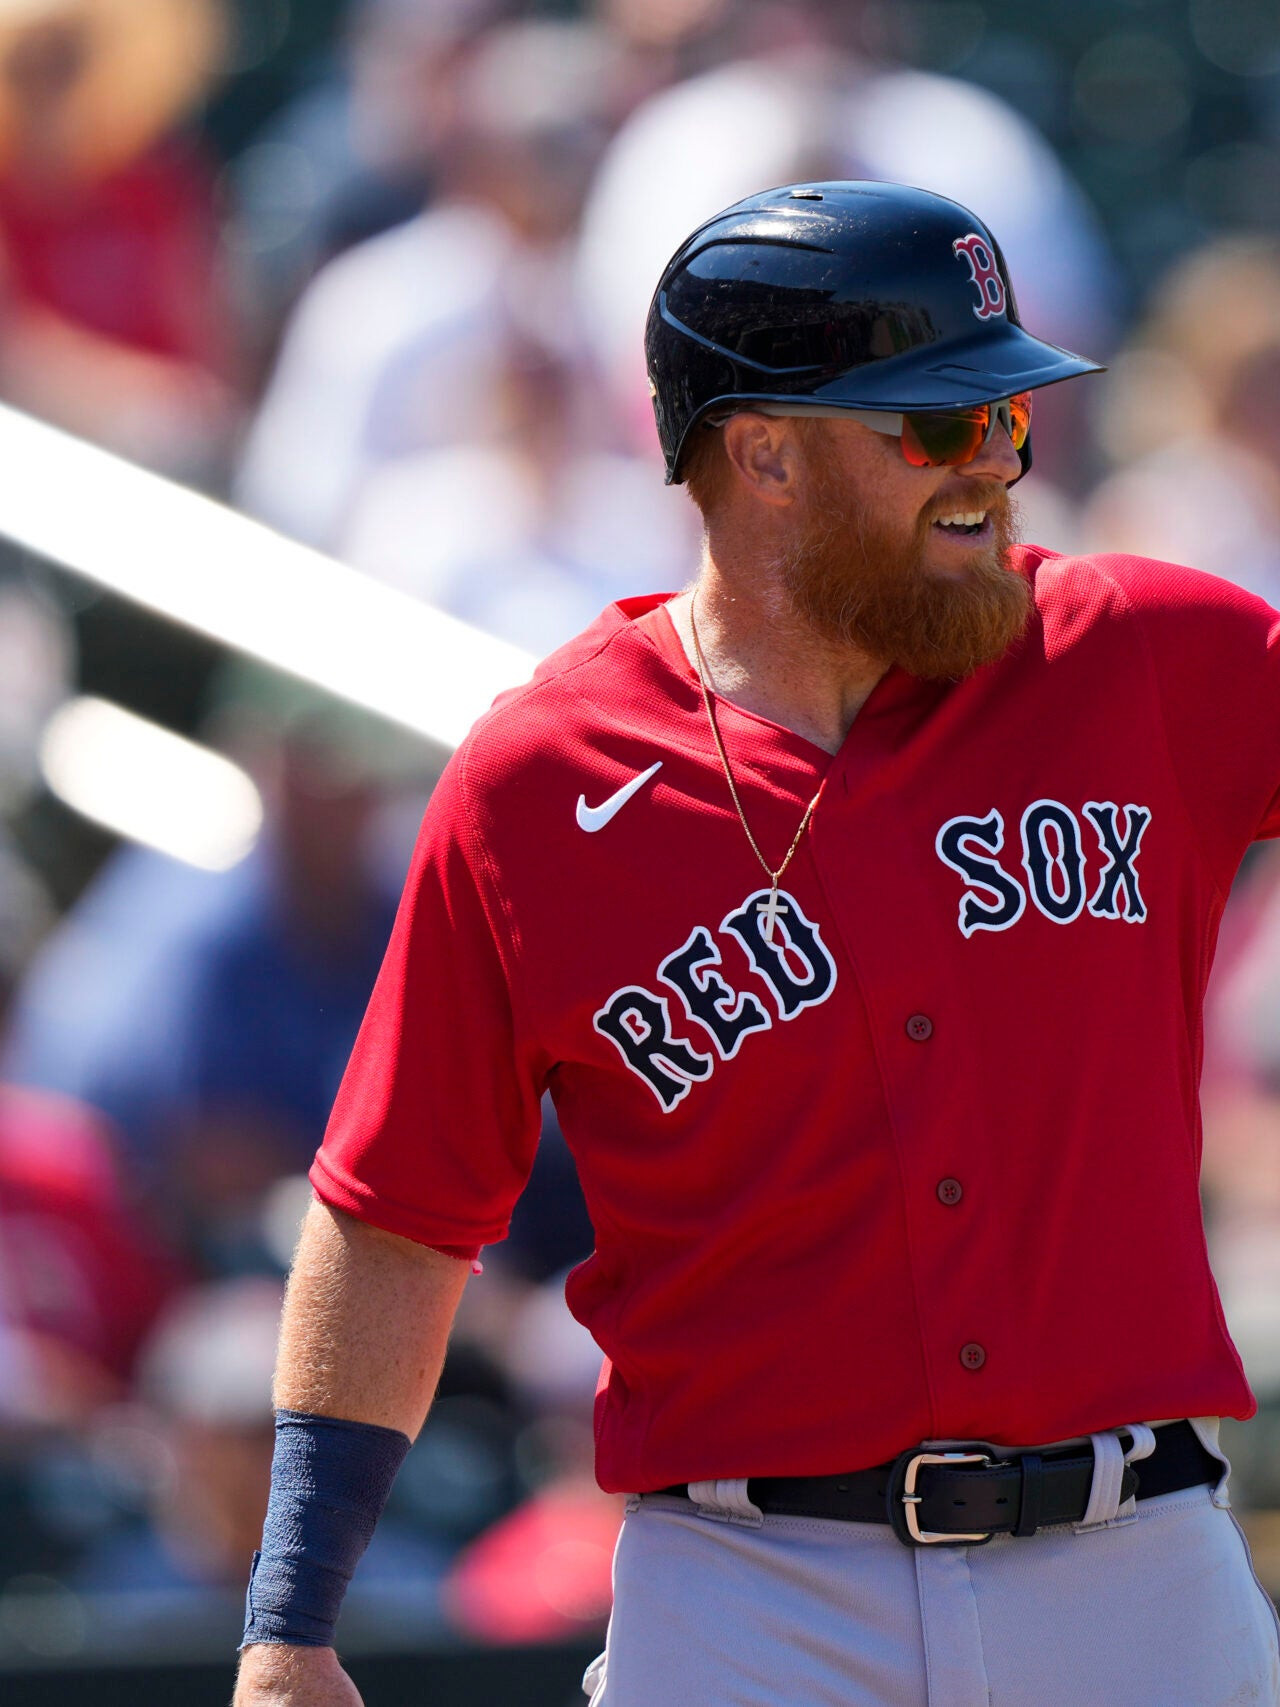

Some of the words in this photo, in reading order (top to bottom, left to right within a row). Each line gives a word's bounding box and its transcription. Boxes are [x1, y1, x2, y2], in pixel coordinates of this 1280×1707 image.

[952, 233, 1006, 321] B
[592, 888, 838, 1114] RED
[935, 798, 1152, 940] SOX
